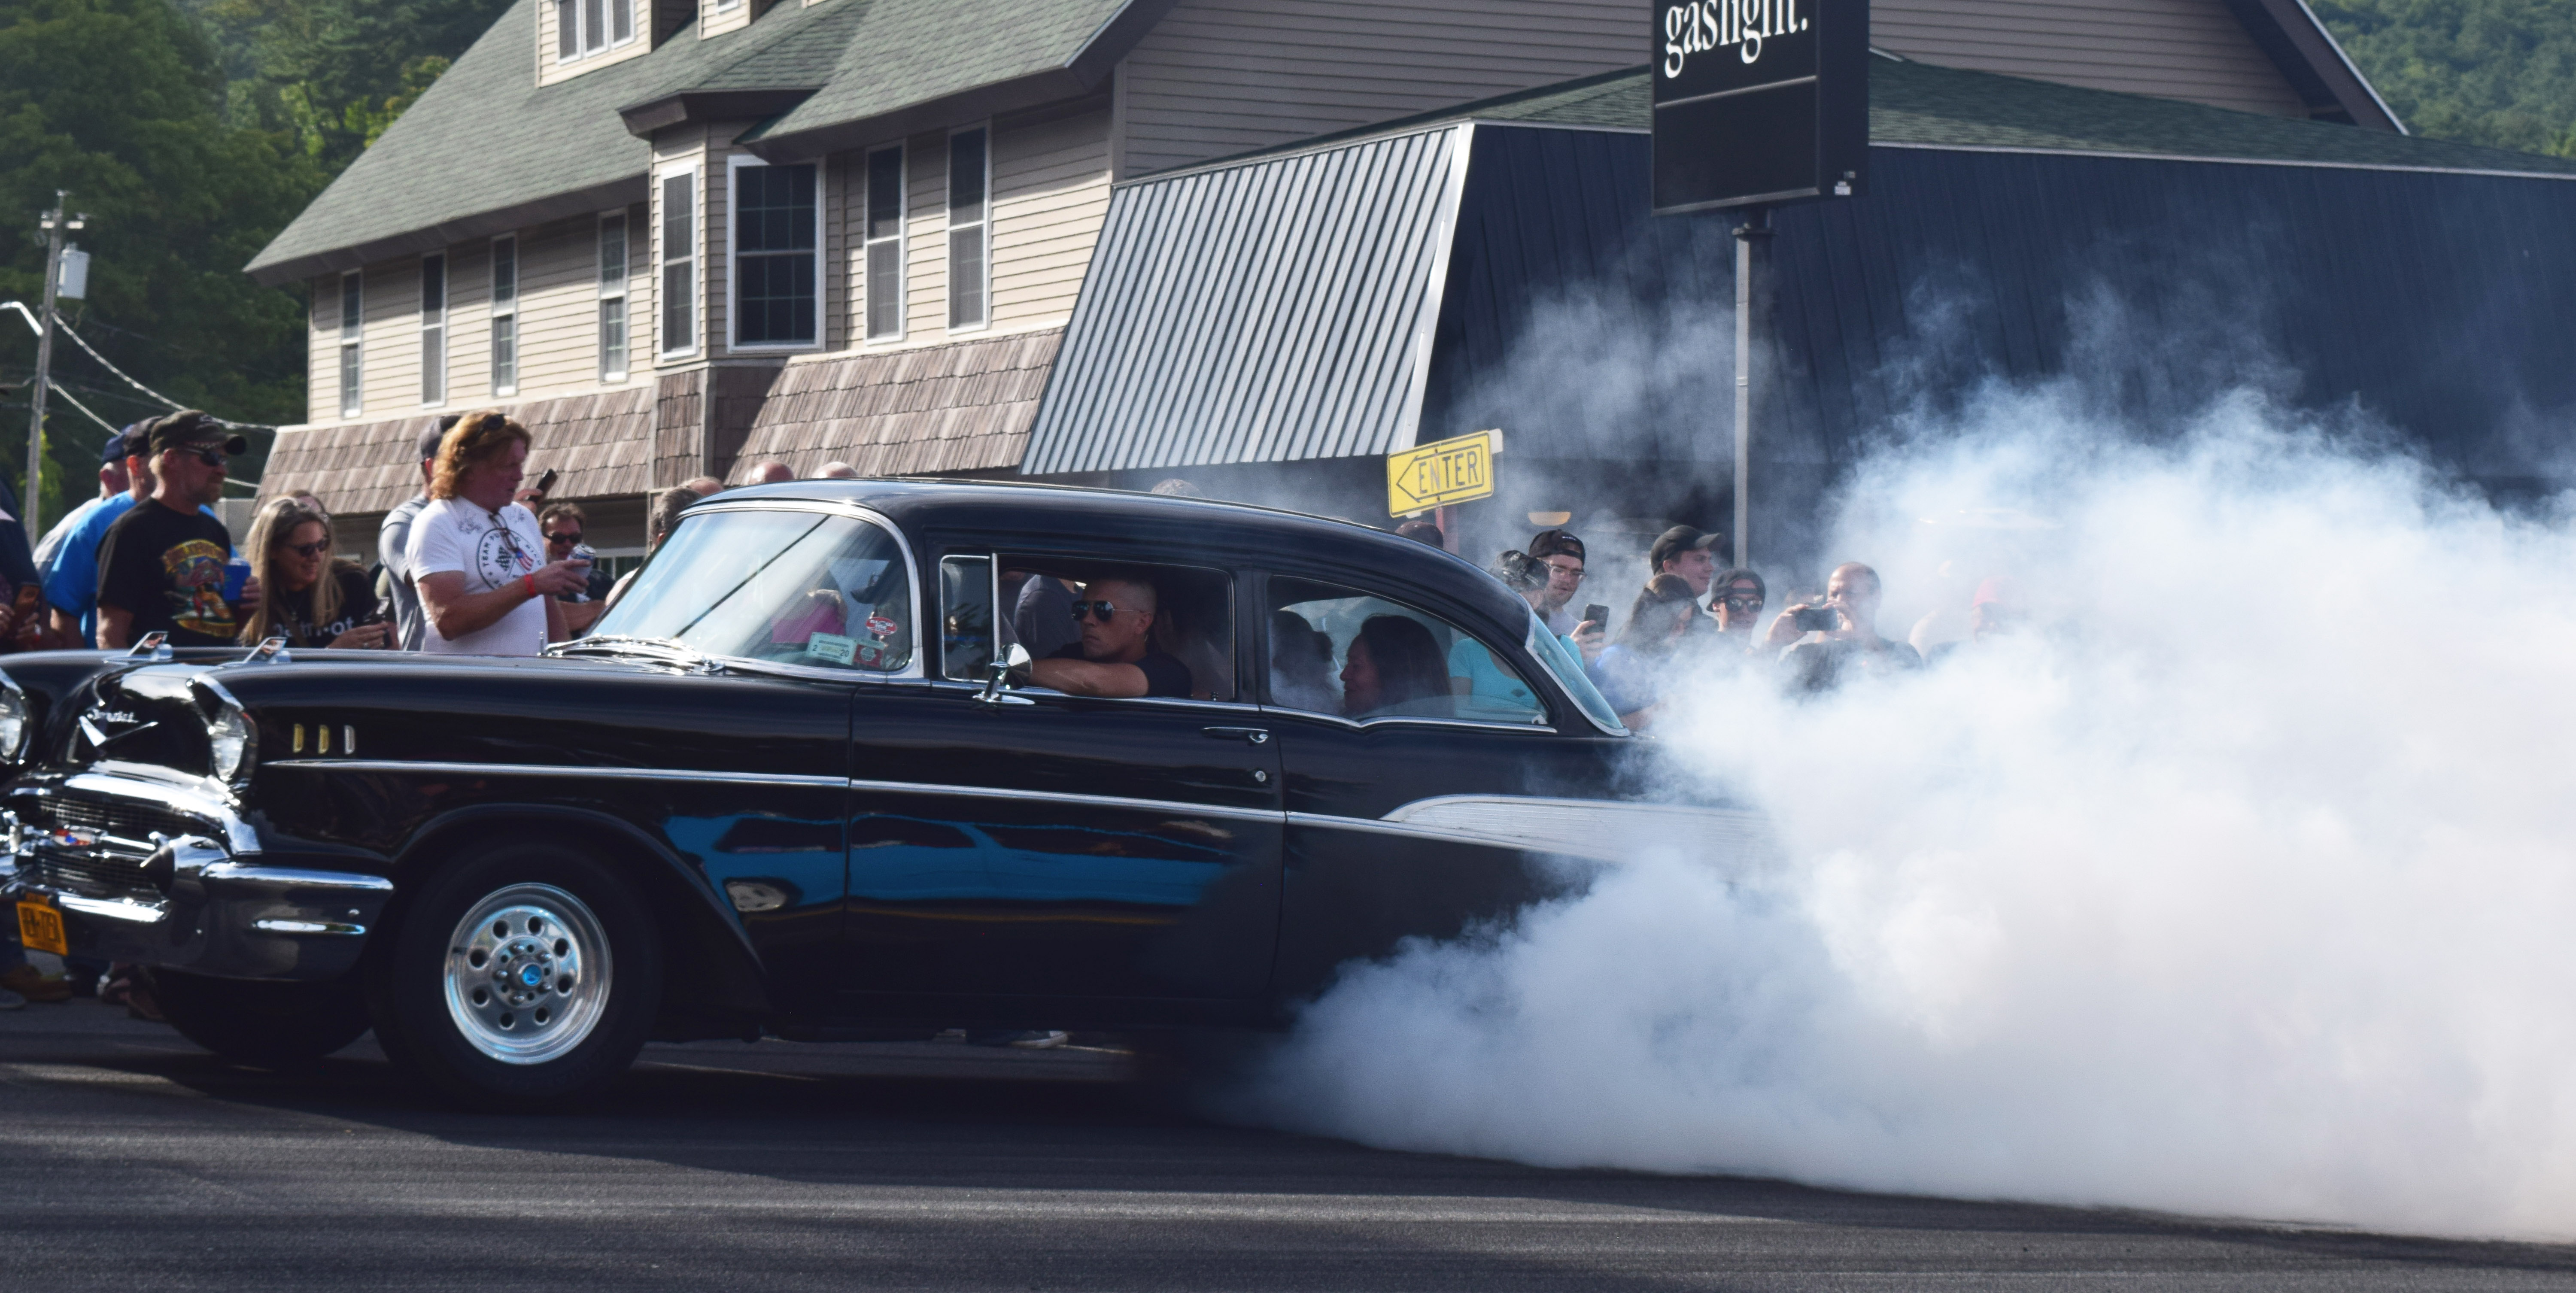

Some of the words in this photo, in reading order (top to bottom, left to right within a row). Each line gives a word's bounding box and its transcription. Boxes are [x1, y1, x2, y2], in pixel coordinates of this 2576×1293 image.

[1419, 451, 1478, 494] ENTER
[482, 542, 490, 567] TEAM
[840, 649, 850, 657] 20
